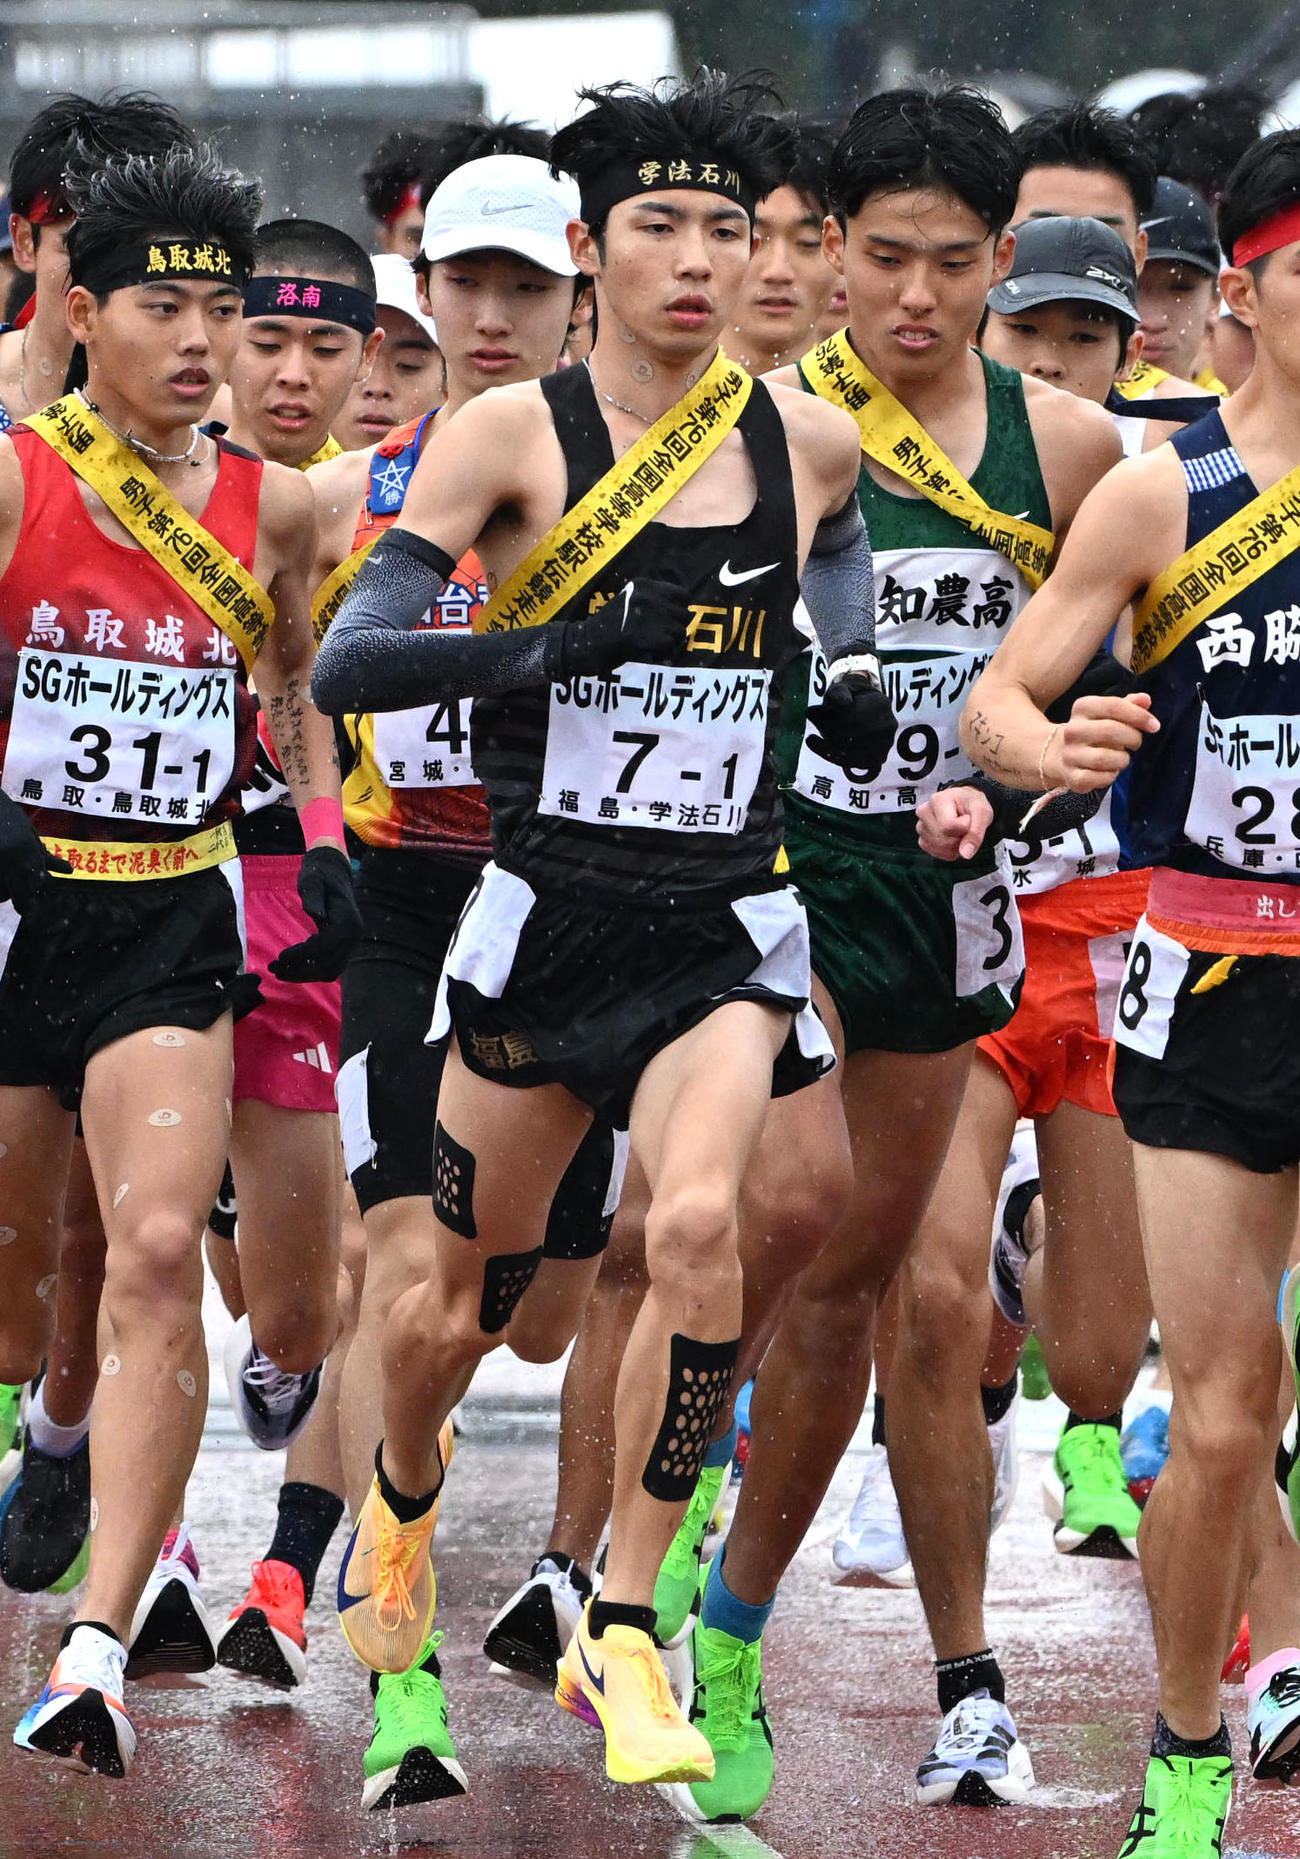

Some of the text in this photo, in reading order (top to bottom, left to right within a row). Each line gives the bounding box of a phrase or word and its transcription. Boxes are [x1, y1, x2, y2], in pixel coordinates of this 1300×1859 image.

[638, 160, 742, 196] 学法石川
[146, 244, 233, 275] 鳥取城北
[277, 282, 322, 309] 洛南
[25, 600, 238, 665] 鳥取城北
[22, 655, 230, 720] SGホールディングス
[64, 724, 212, 794] 31-1
[389, 760, 477, 782] 宮城・
[612, 730, 739, 800] 7-1
[558, 788, 743, 827] 福島・学法石川
[1232, 785, 1300, 845] 2
[1205, 835, 1300, 869] 兵庫・
[1119, 941, 1151, 1031] 8
